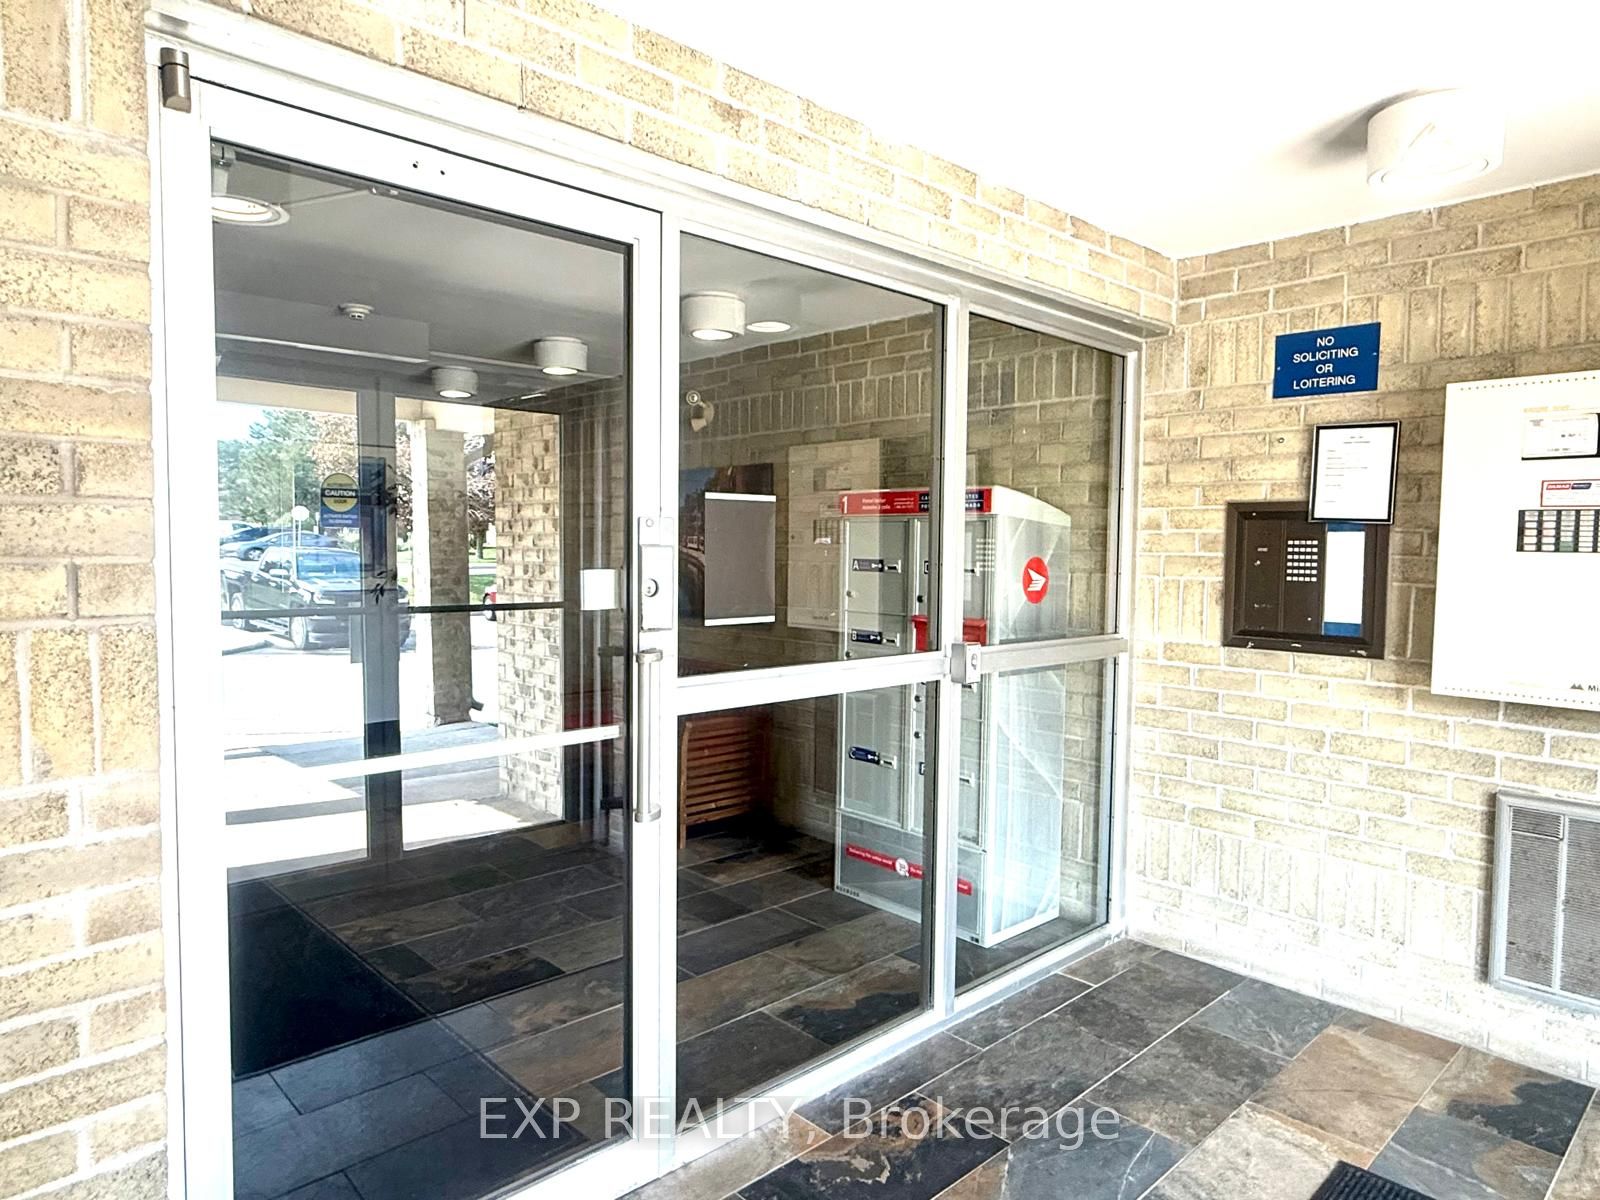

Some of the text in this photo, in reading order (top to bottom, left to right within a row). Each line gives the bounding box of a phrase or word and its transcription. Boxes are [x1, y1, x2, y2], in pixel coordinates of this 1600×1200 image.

[1316, 336, 1335, 347] NO
[1292, 346, 1359, 364] SOLICITING
[1315, 363, 1334, 374] OR
[1292, 374, 1356, 390] LOITERING
[324, 489, 356, 497] CAUTION
[841, 495, 848, 514] 1
[852, 560, 859, 570] A
